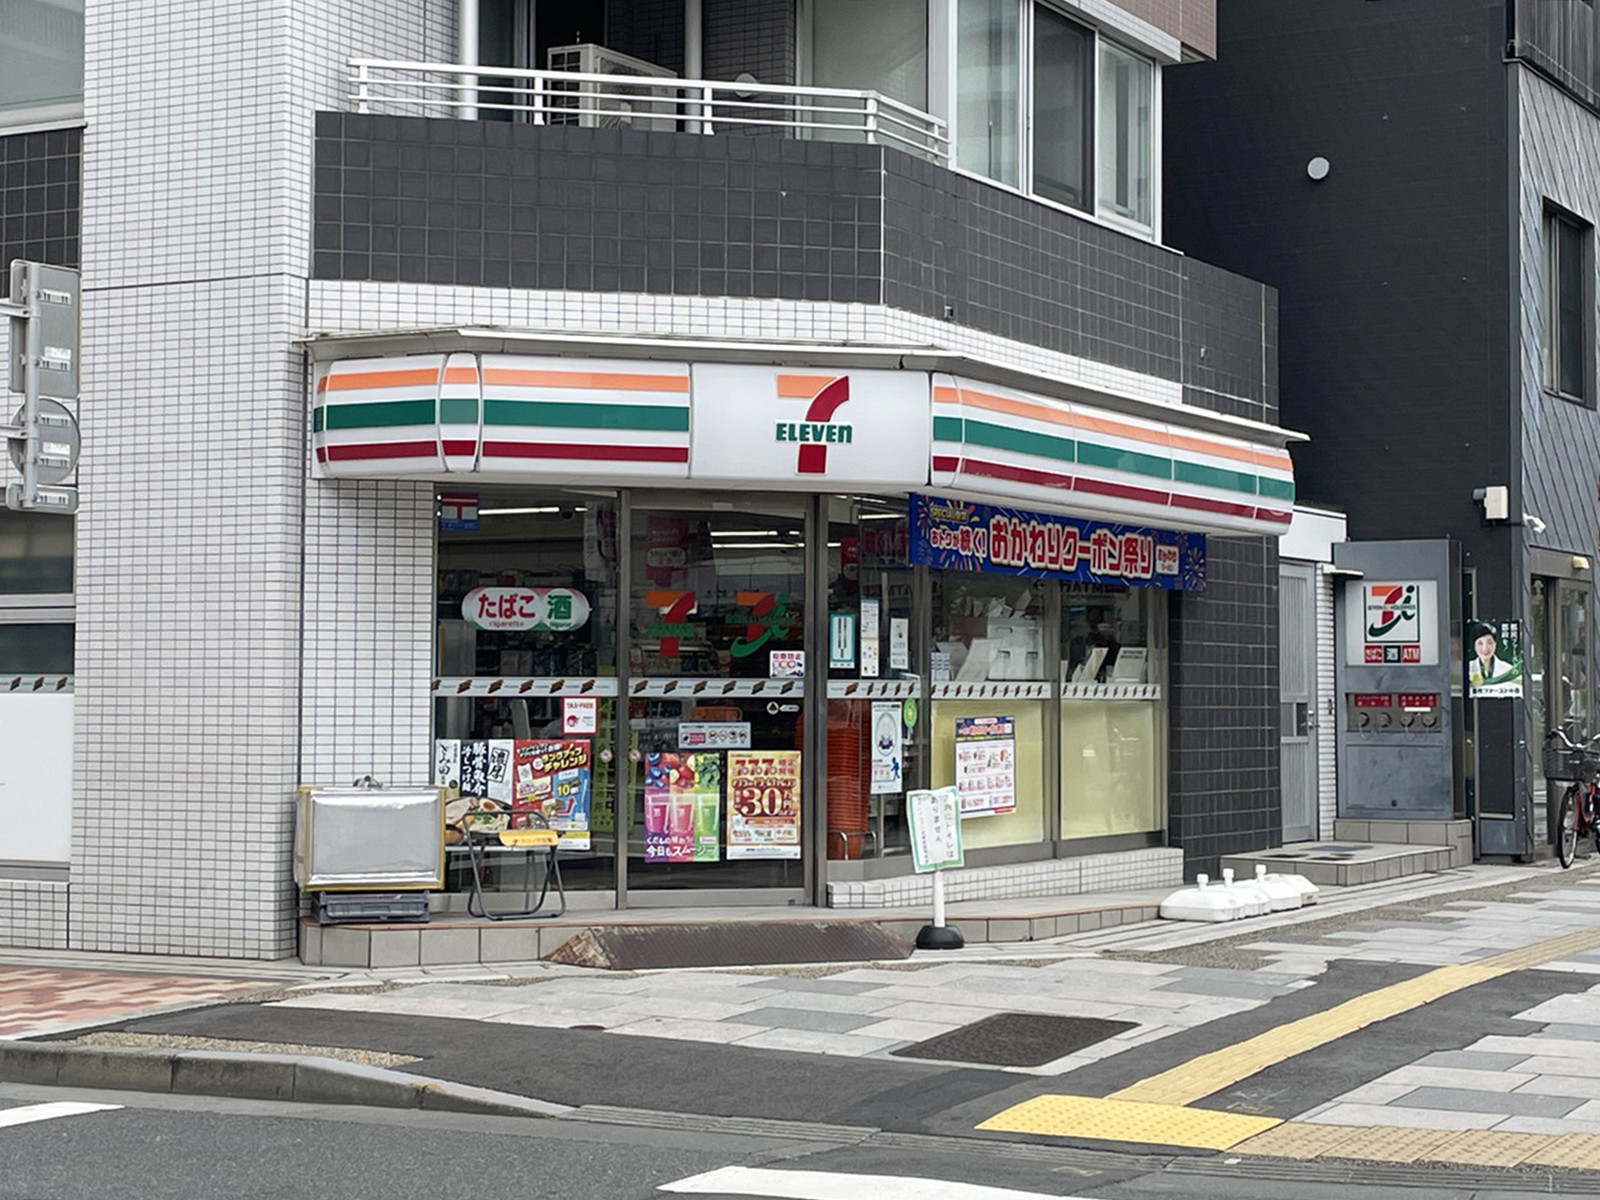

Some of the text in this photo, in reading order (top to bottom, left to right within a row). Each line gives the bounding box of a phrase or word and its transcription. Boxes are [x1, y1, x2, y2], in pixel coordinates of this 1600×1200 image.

[990, 514, 1154, 580] おかわりクーポン祭り
[478, 593, 572, 620] たばこ 酒
[1402, 647, 1420, 661] ATM
[557, 784, 571, 797] 10
[740, 787, 783, 816] 30
